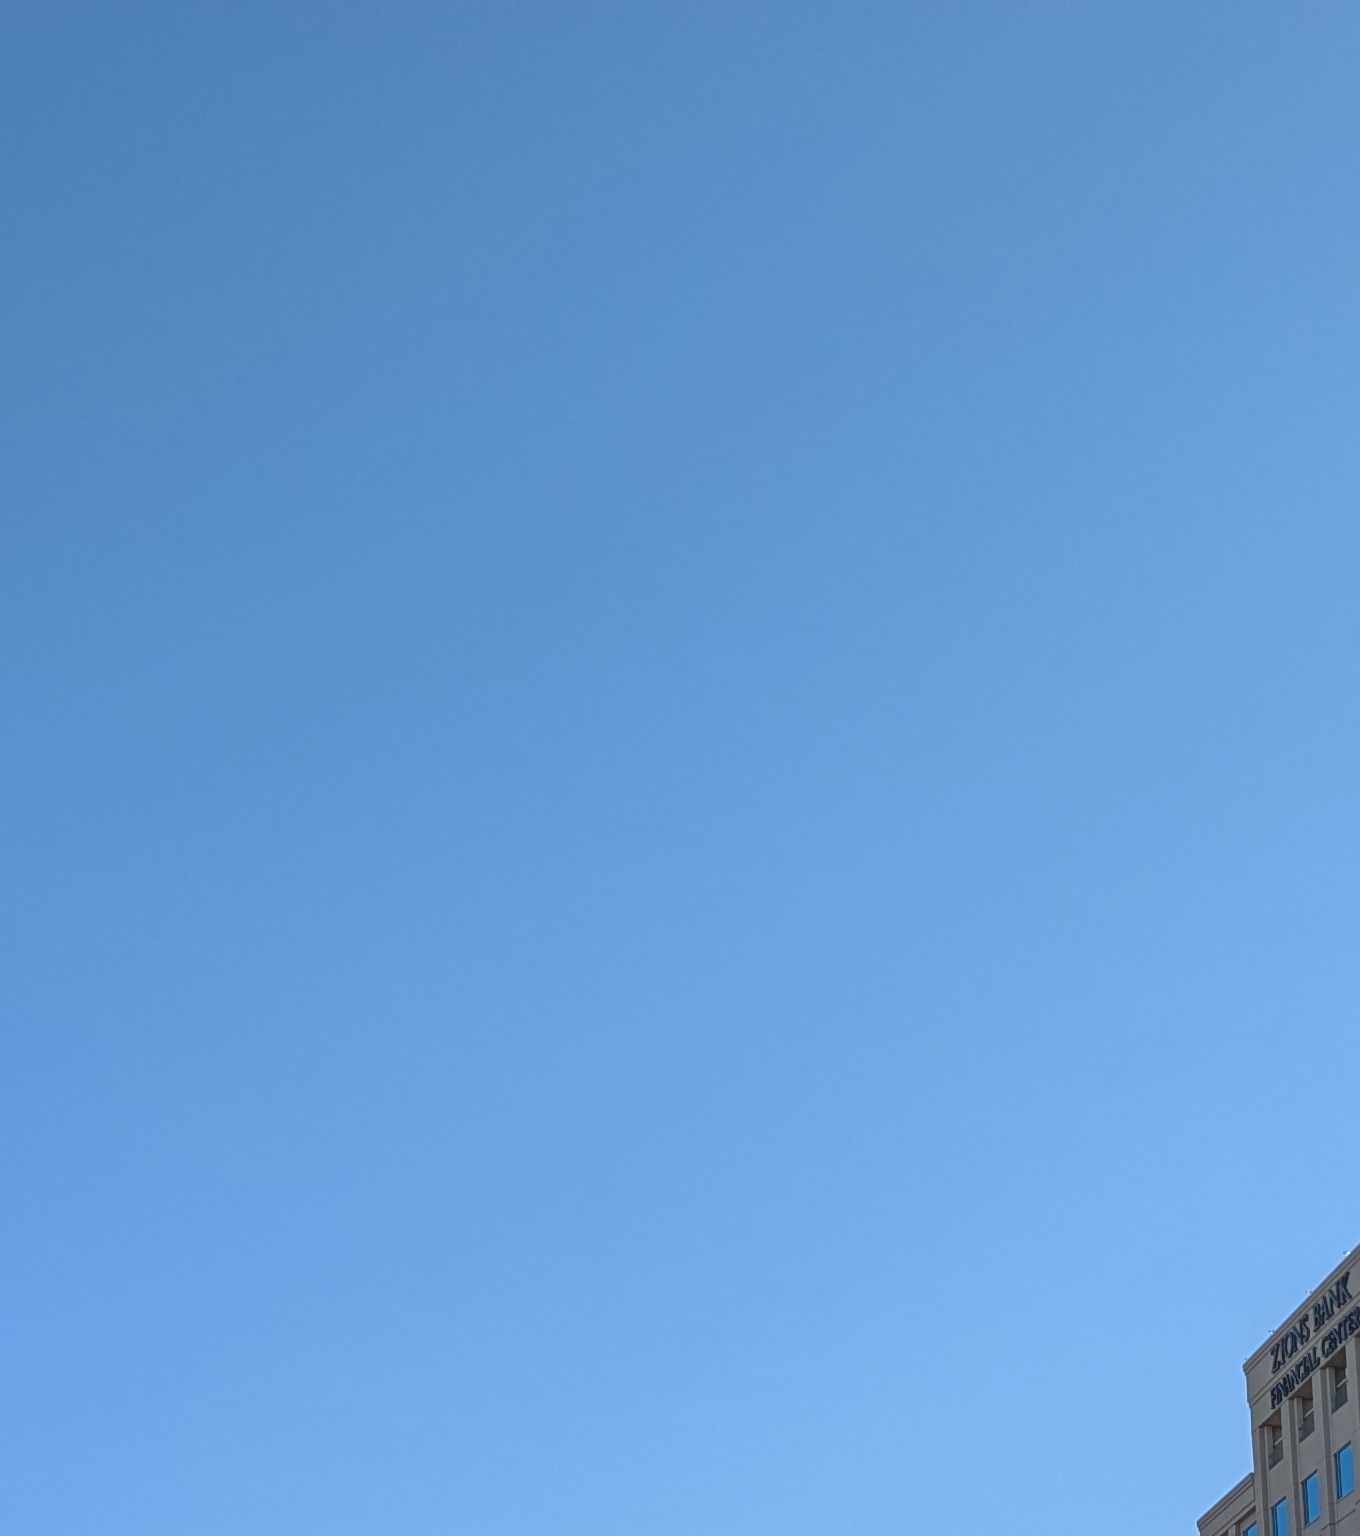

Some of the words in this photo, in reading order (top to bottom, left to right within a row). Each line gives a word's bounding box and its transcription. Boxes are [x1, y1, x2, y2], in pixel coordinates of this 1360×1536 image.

[1269, 1313, 1311, 1375] ZIONS
[1311, 1270, 1353, 1333] BANK
[1269, 1346, 1321, 1410] FINANCIAL
